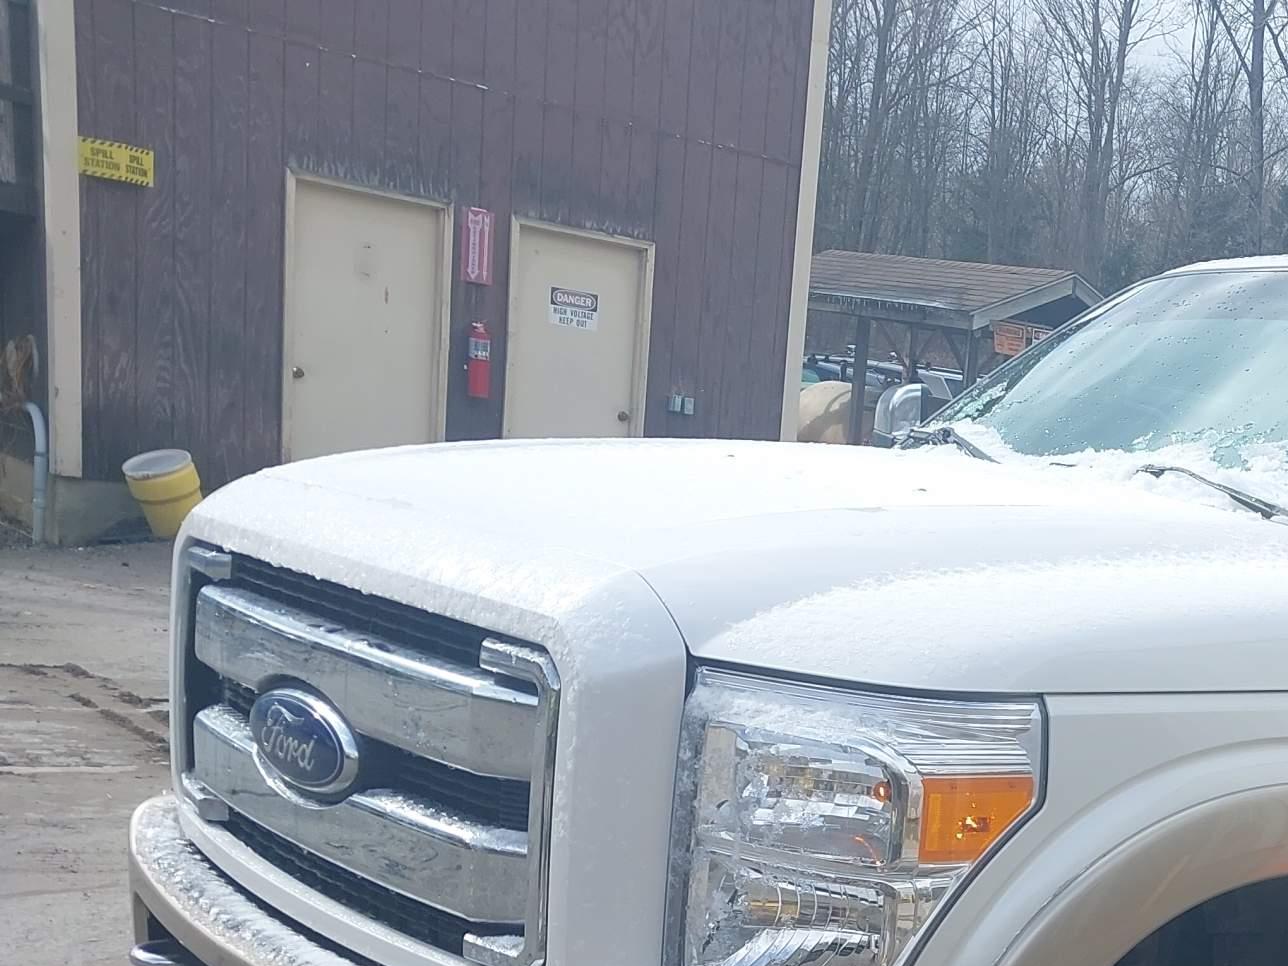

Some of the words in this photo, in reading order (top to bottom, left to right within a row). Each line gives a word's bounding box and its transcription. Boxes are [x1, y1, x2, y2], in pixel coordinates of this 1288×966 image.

[90, 147, 113, 160] SPILL
[129, 154, 144, 166] SPILL
[84, 157, 120, 171] STATION
[126, 164, 148, 178] STATION
[557, 293, 592, 307] DANGER
[559, 316, 574, 325] KEEP
[570, 310, 594, 320] VOLTAGE
[261, 704, 317, 772] Ford
